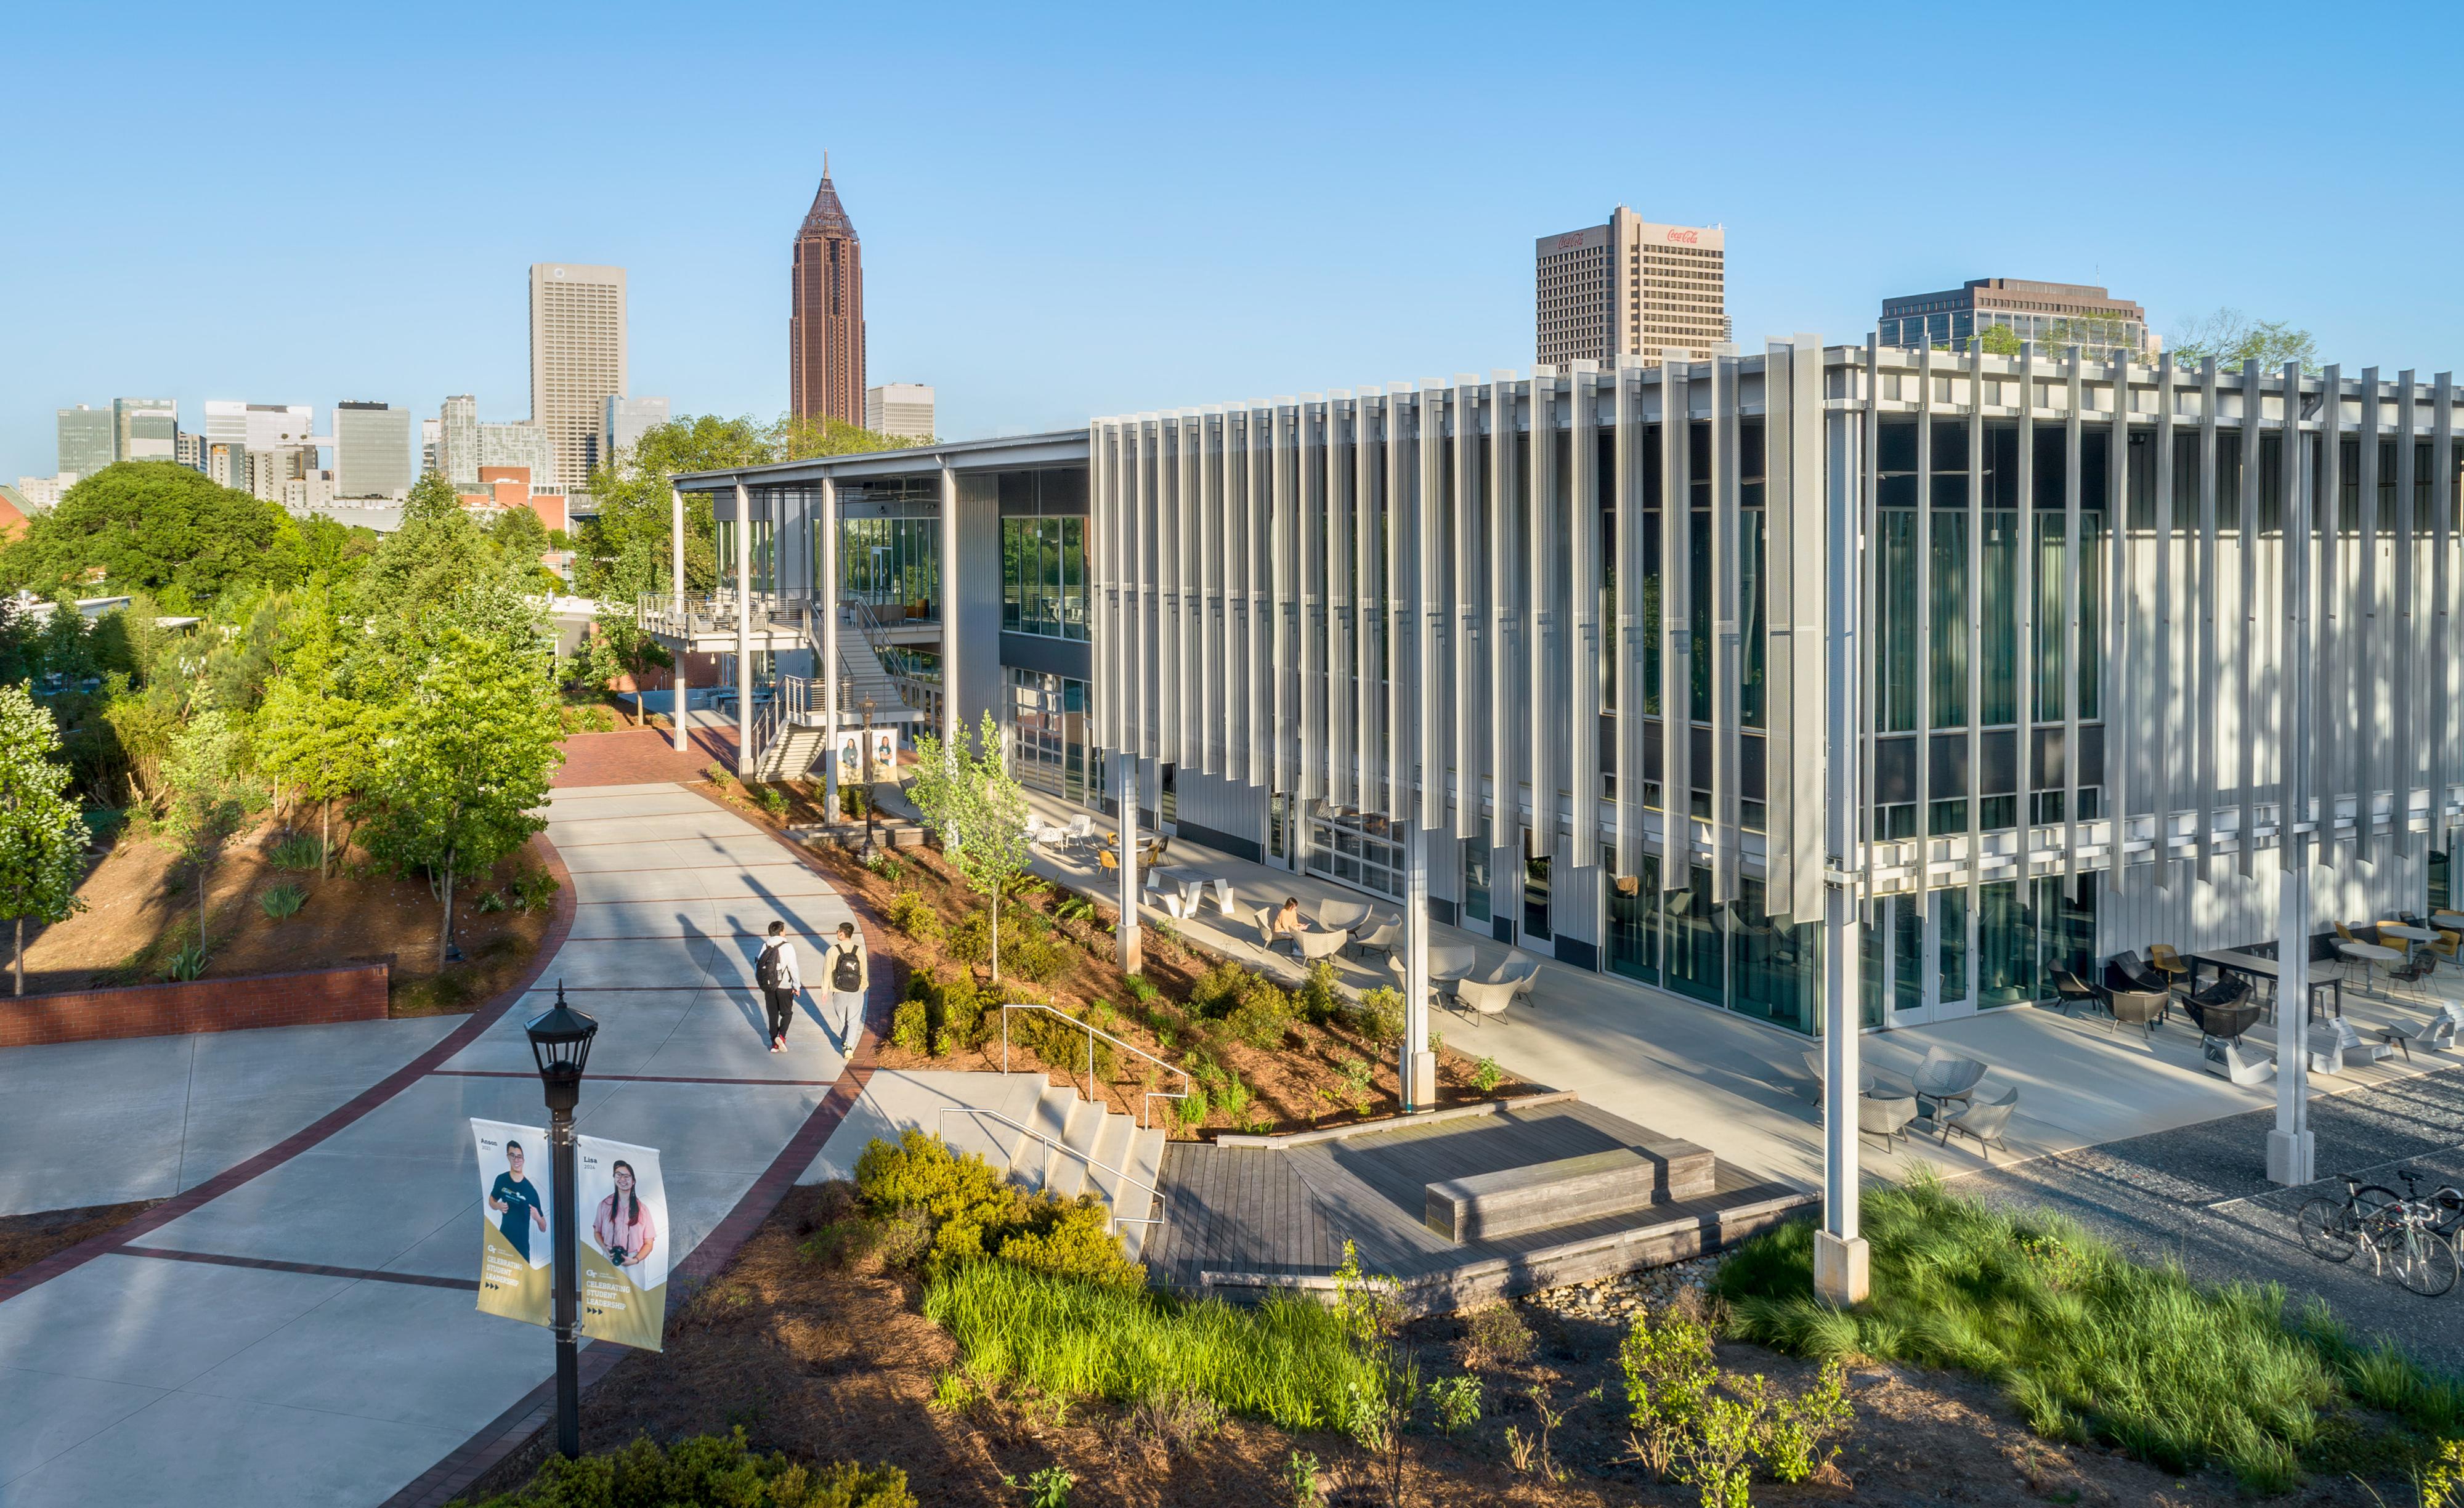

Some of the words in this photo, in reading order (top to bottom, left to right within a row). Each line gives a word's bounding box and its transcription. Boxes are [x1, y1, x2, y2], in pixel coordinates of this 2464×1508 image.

[487, 1255, 523, 1271] CELEBRATING
[487, 1264, 513, 1276] STUDENT
[485, 1272, 519, 1287] LEADERSHIP
[586, 1280, 631, 1293] CELEBRATING
[586, 1289, 617, 1300] STUDENT
[586, 1297, 626, 1310] LEADERSHIP
